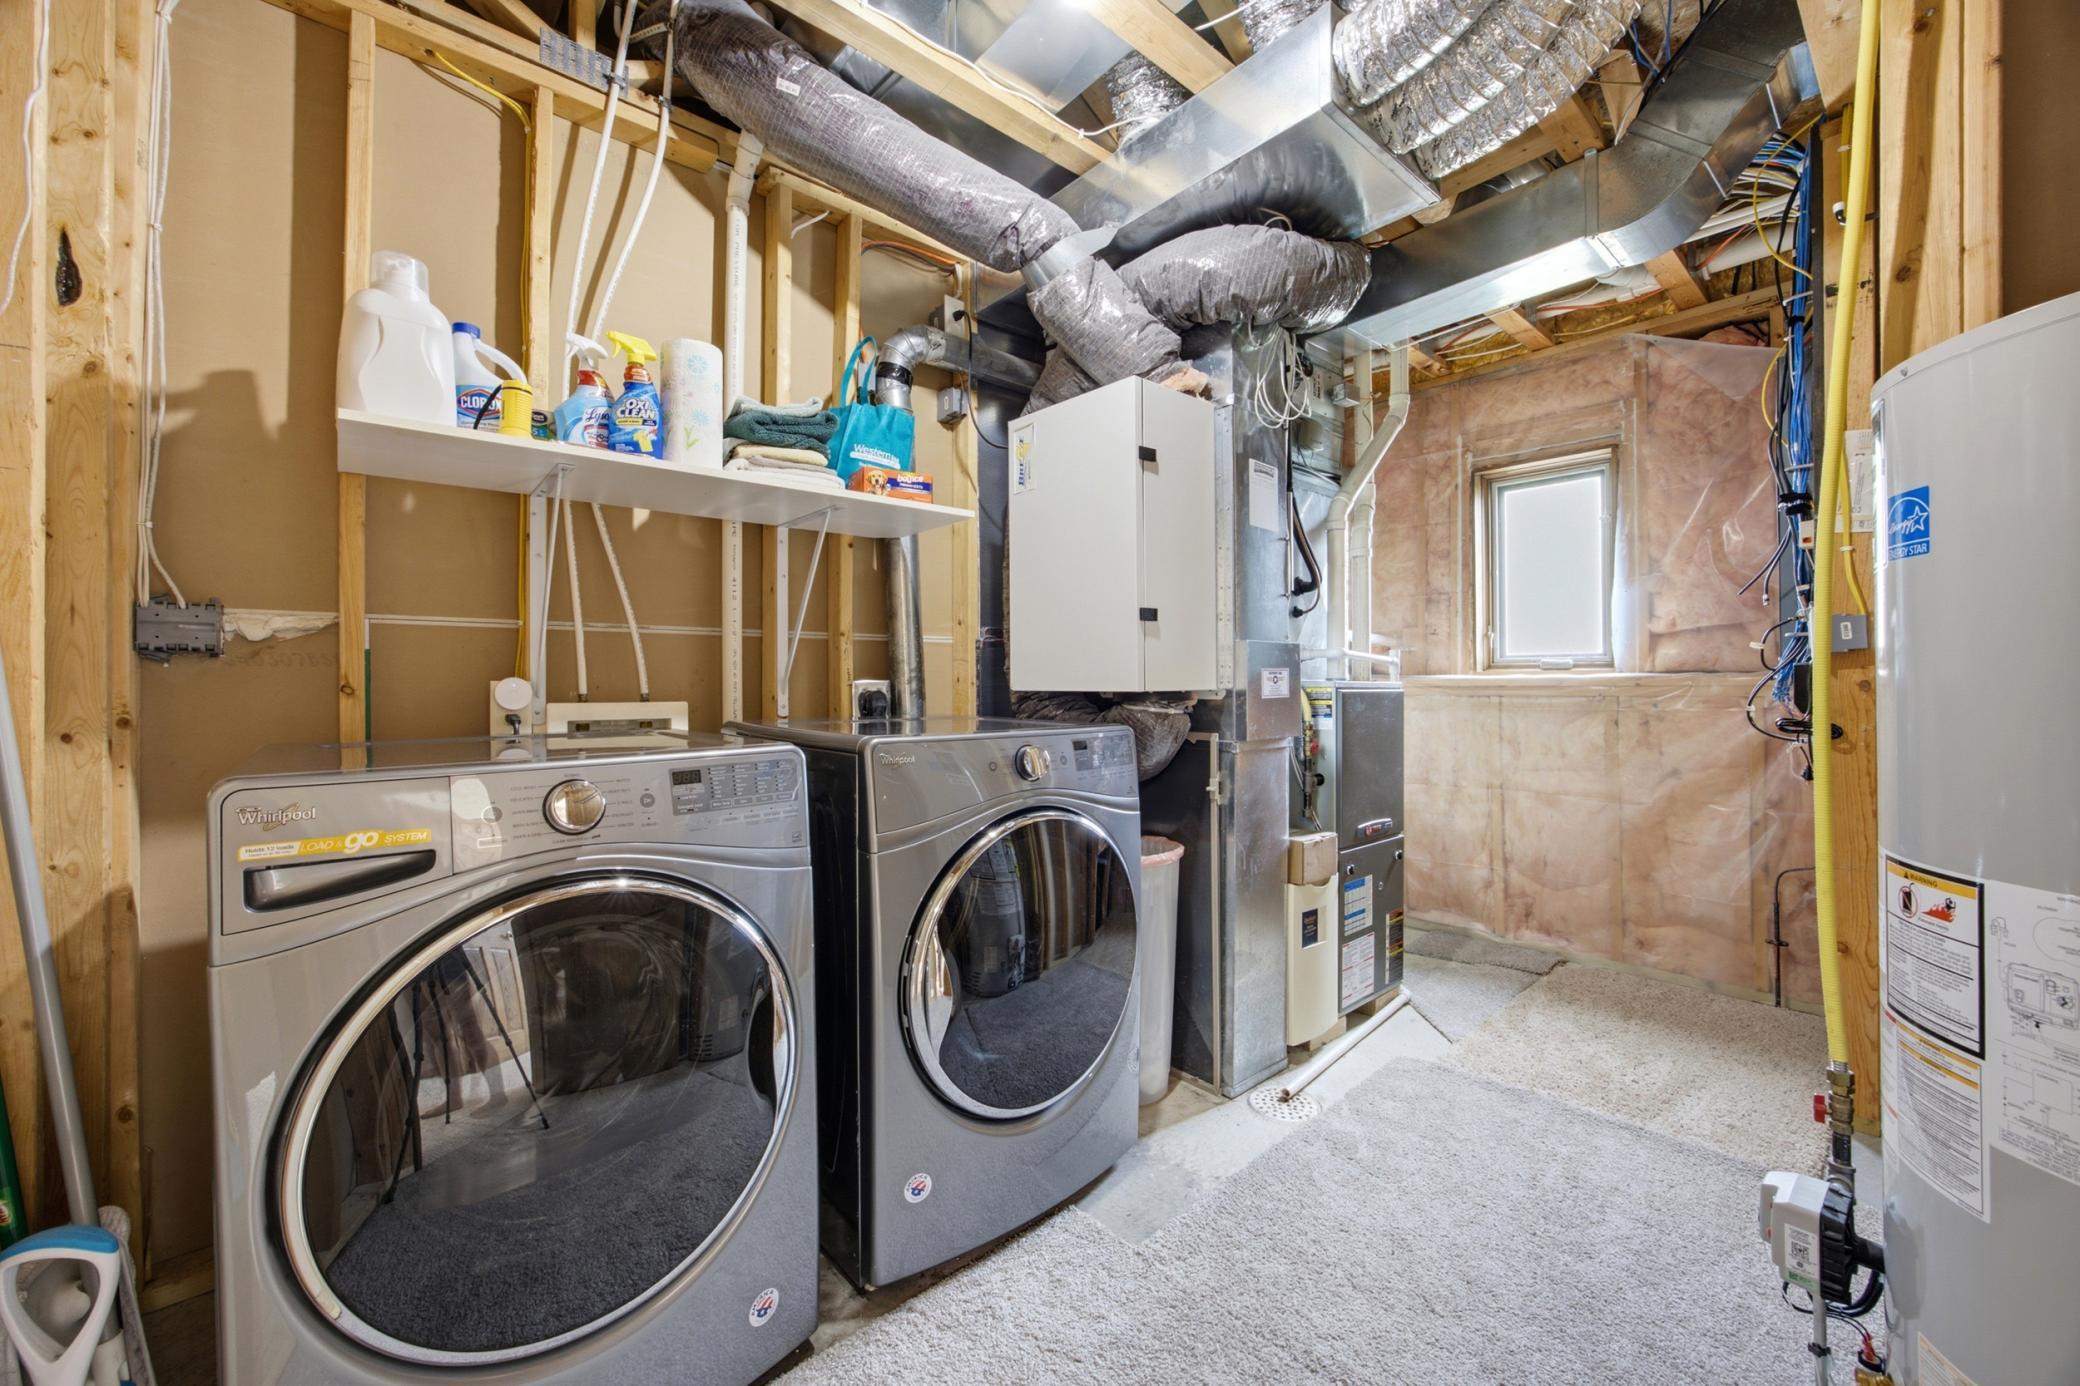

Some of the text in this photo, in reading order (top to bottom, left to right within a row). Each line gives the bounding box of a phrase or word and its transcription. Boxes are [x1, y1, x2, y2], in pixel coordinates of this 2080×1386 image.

[625, 398, 650, 410] OXI
[585, 408, 610, 424] Lyso
[616, 407, 655, 420] CLEAN
[1908, 543, 1928, 556] STAR
[236, 807, 316, 826] Whirlpool
[300, 840, 334, 852] LOAD
[343, 831, 380, 854] go
[383, 832, 427, 844] SYSTEM
